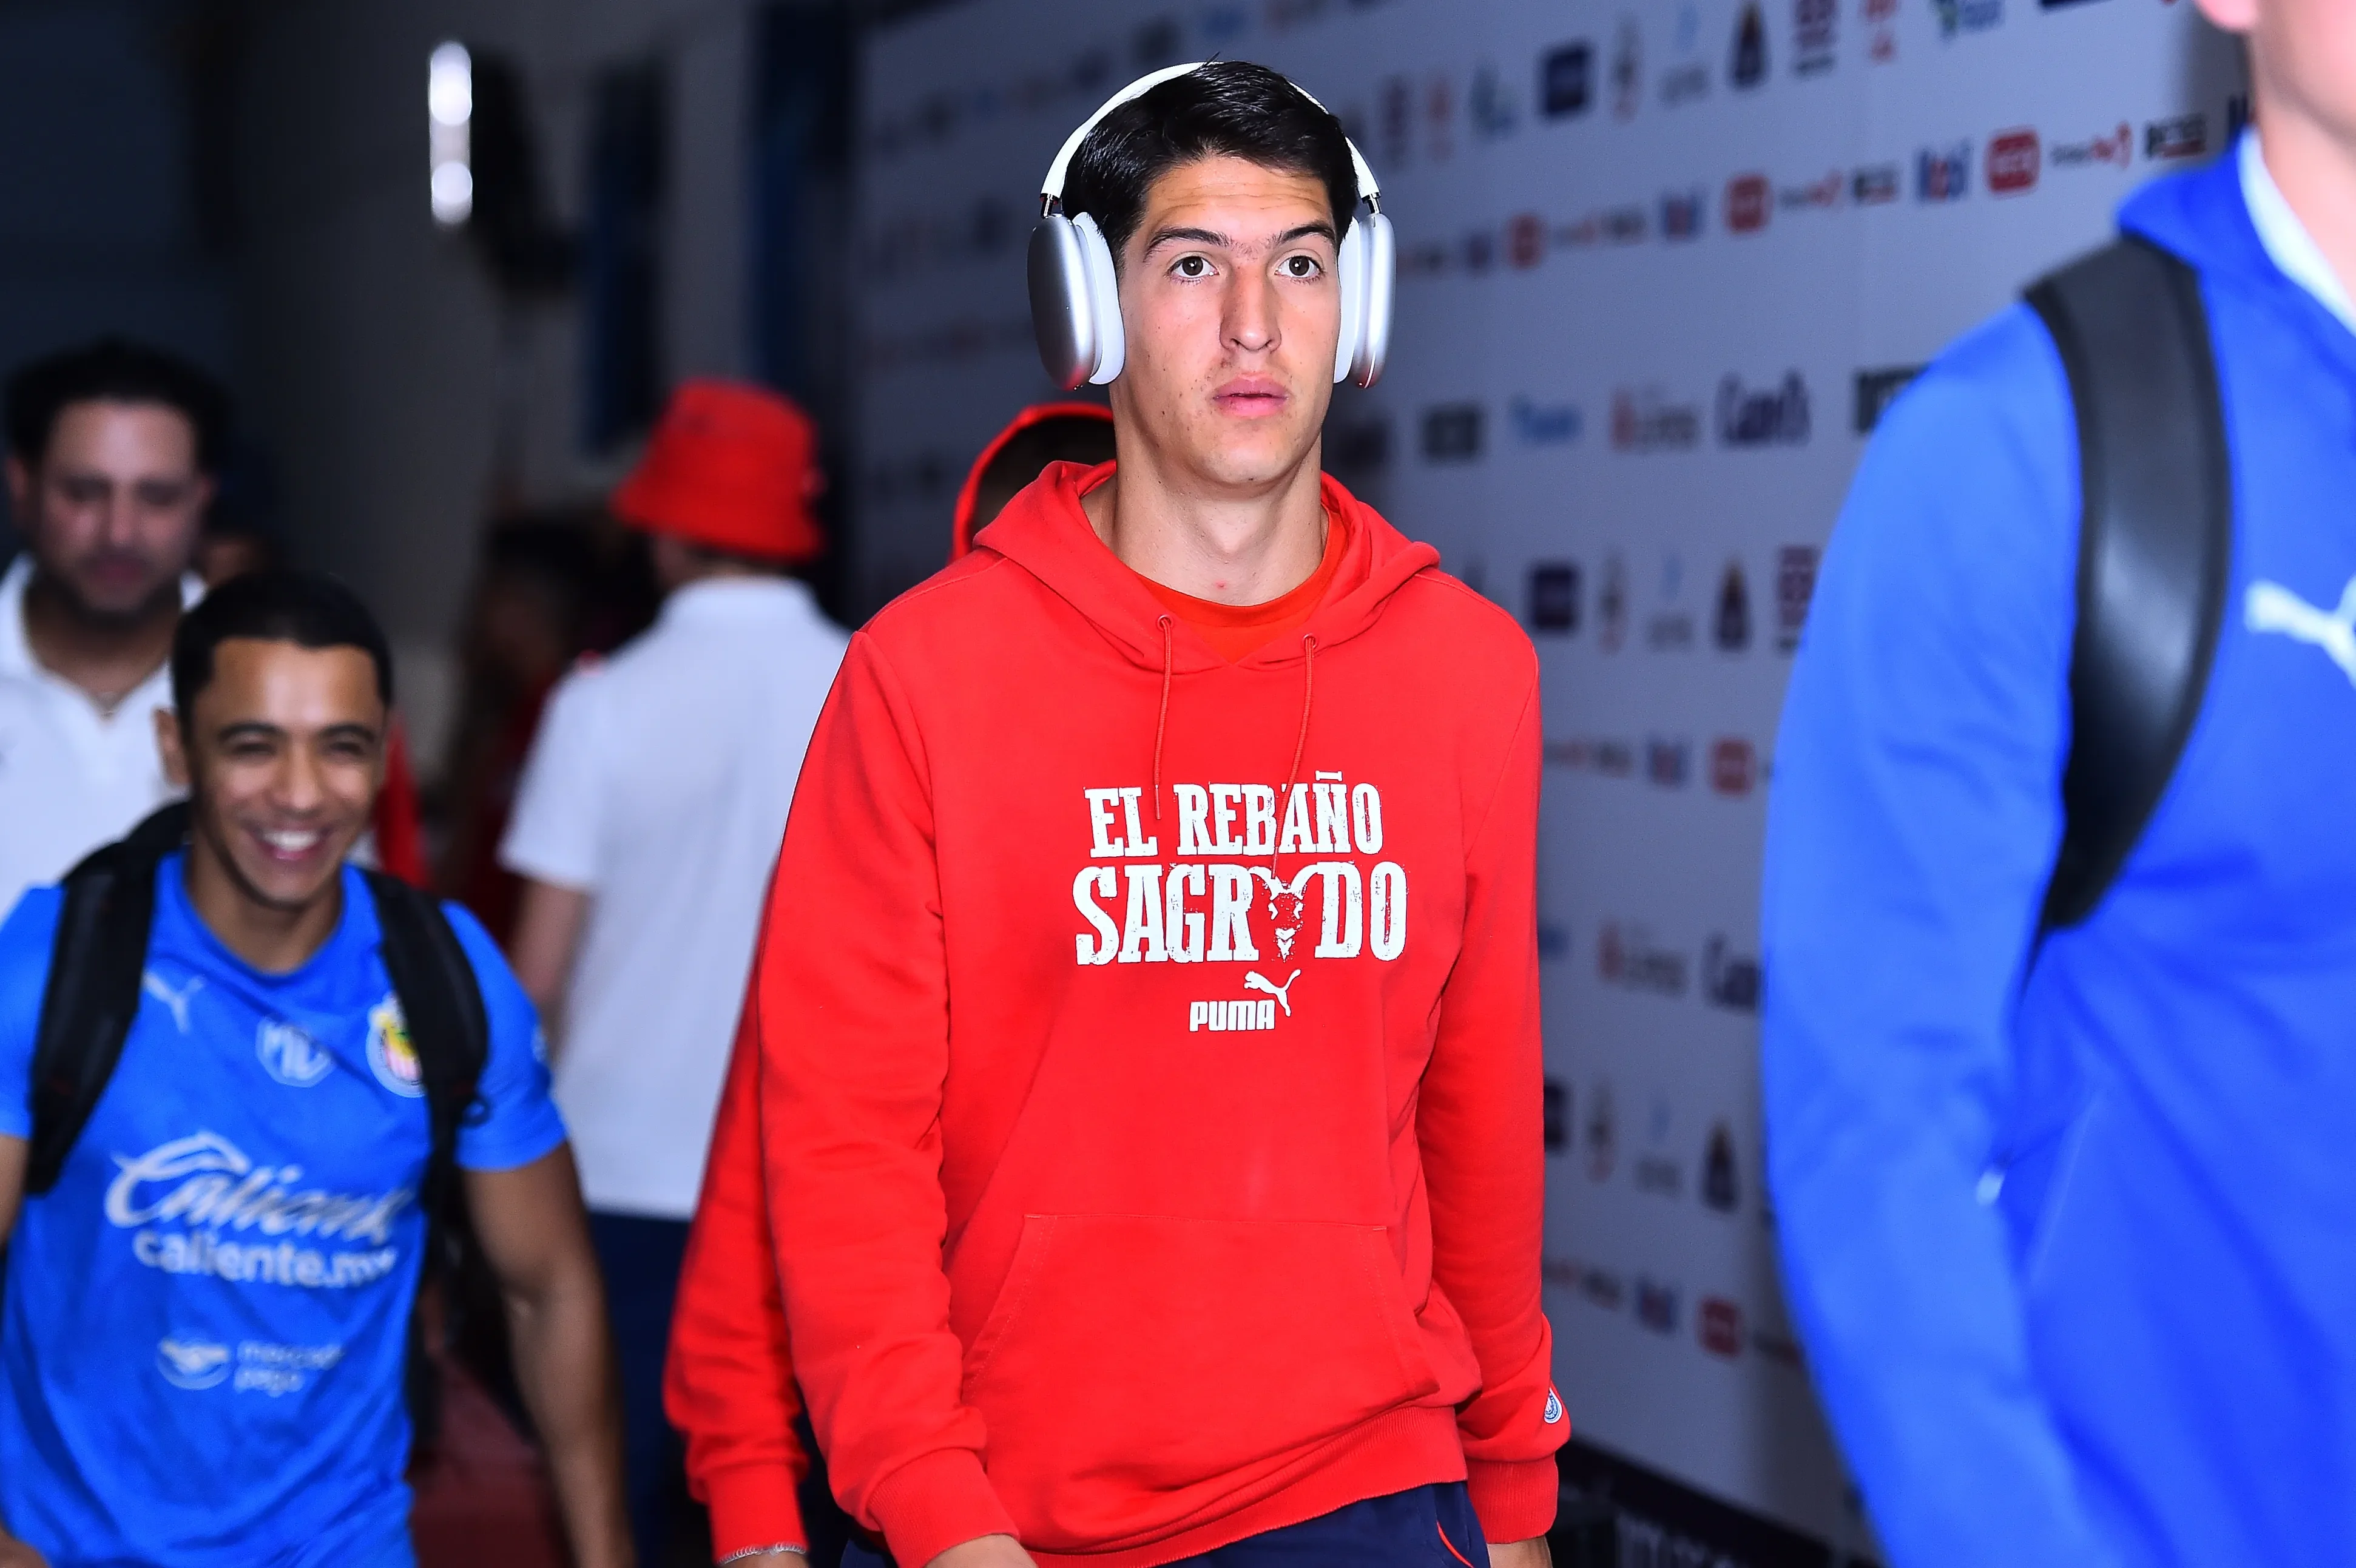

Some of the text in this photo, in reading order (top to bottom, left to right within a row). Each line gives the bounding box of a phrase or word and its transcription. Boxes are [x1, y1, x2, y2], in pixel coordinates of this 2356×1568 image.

[1084, 770, 1384, 858] EL REBAÑO
[1072, 861, 1408, 966] SAGRDO
[1189, 999, 1275, 1032] PUMA
